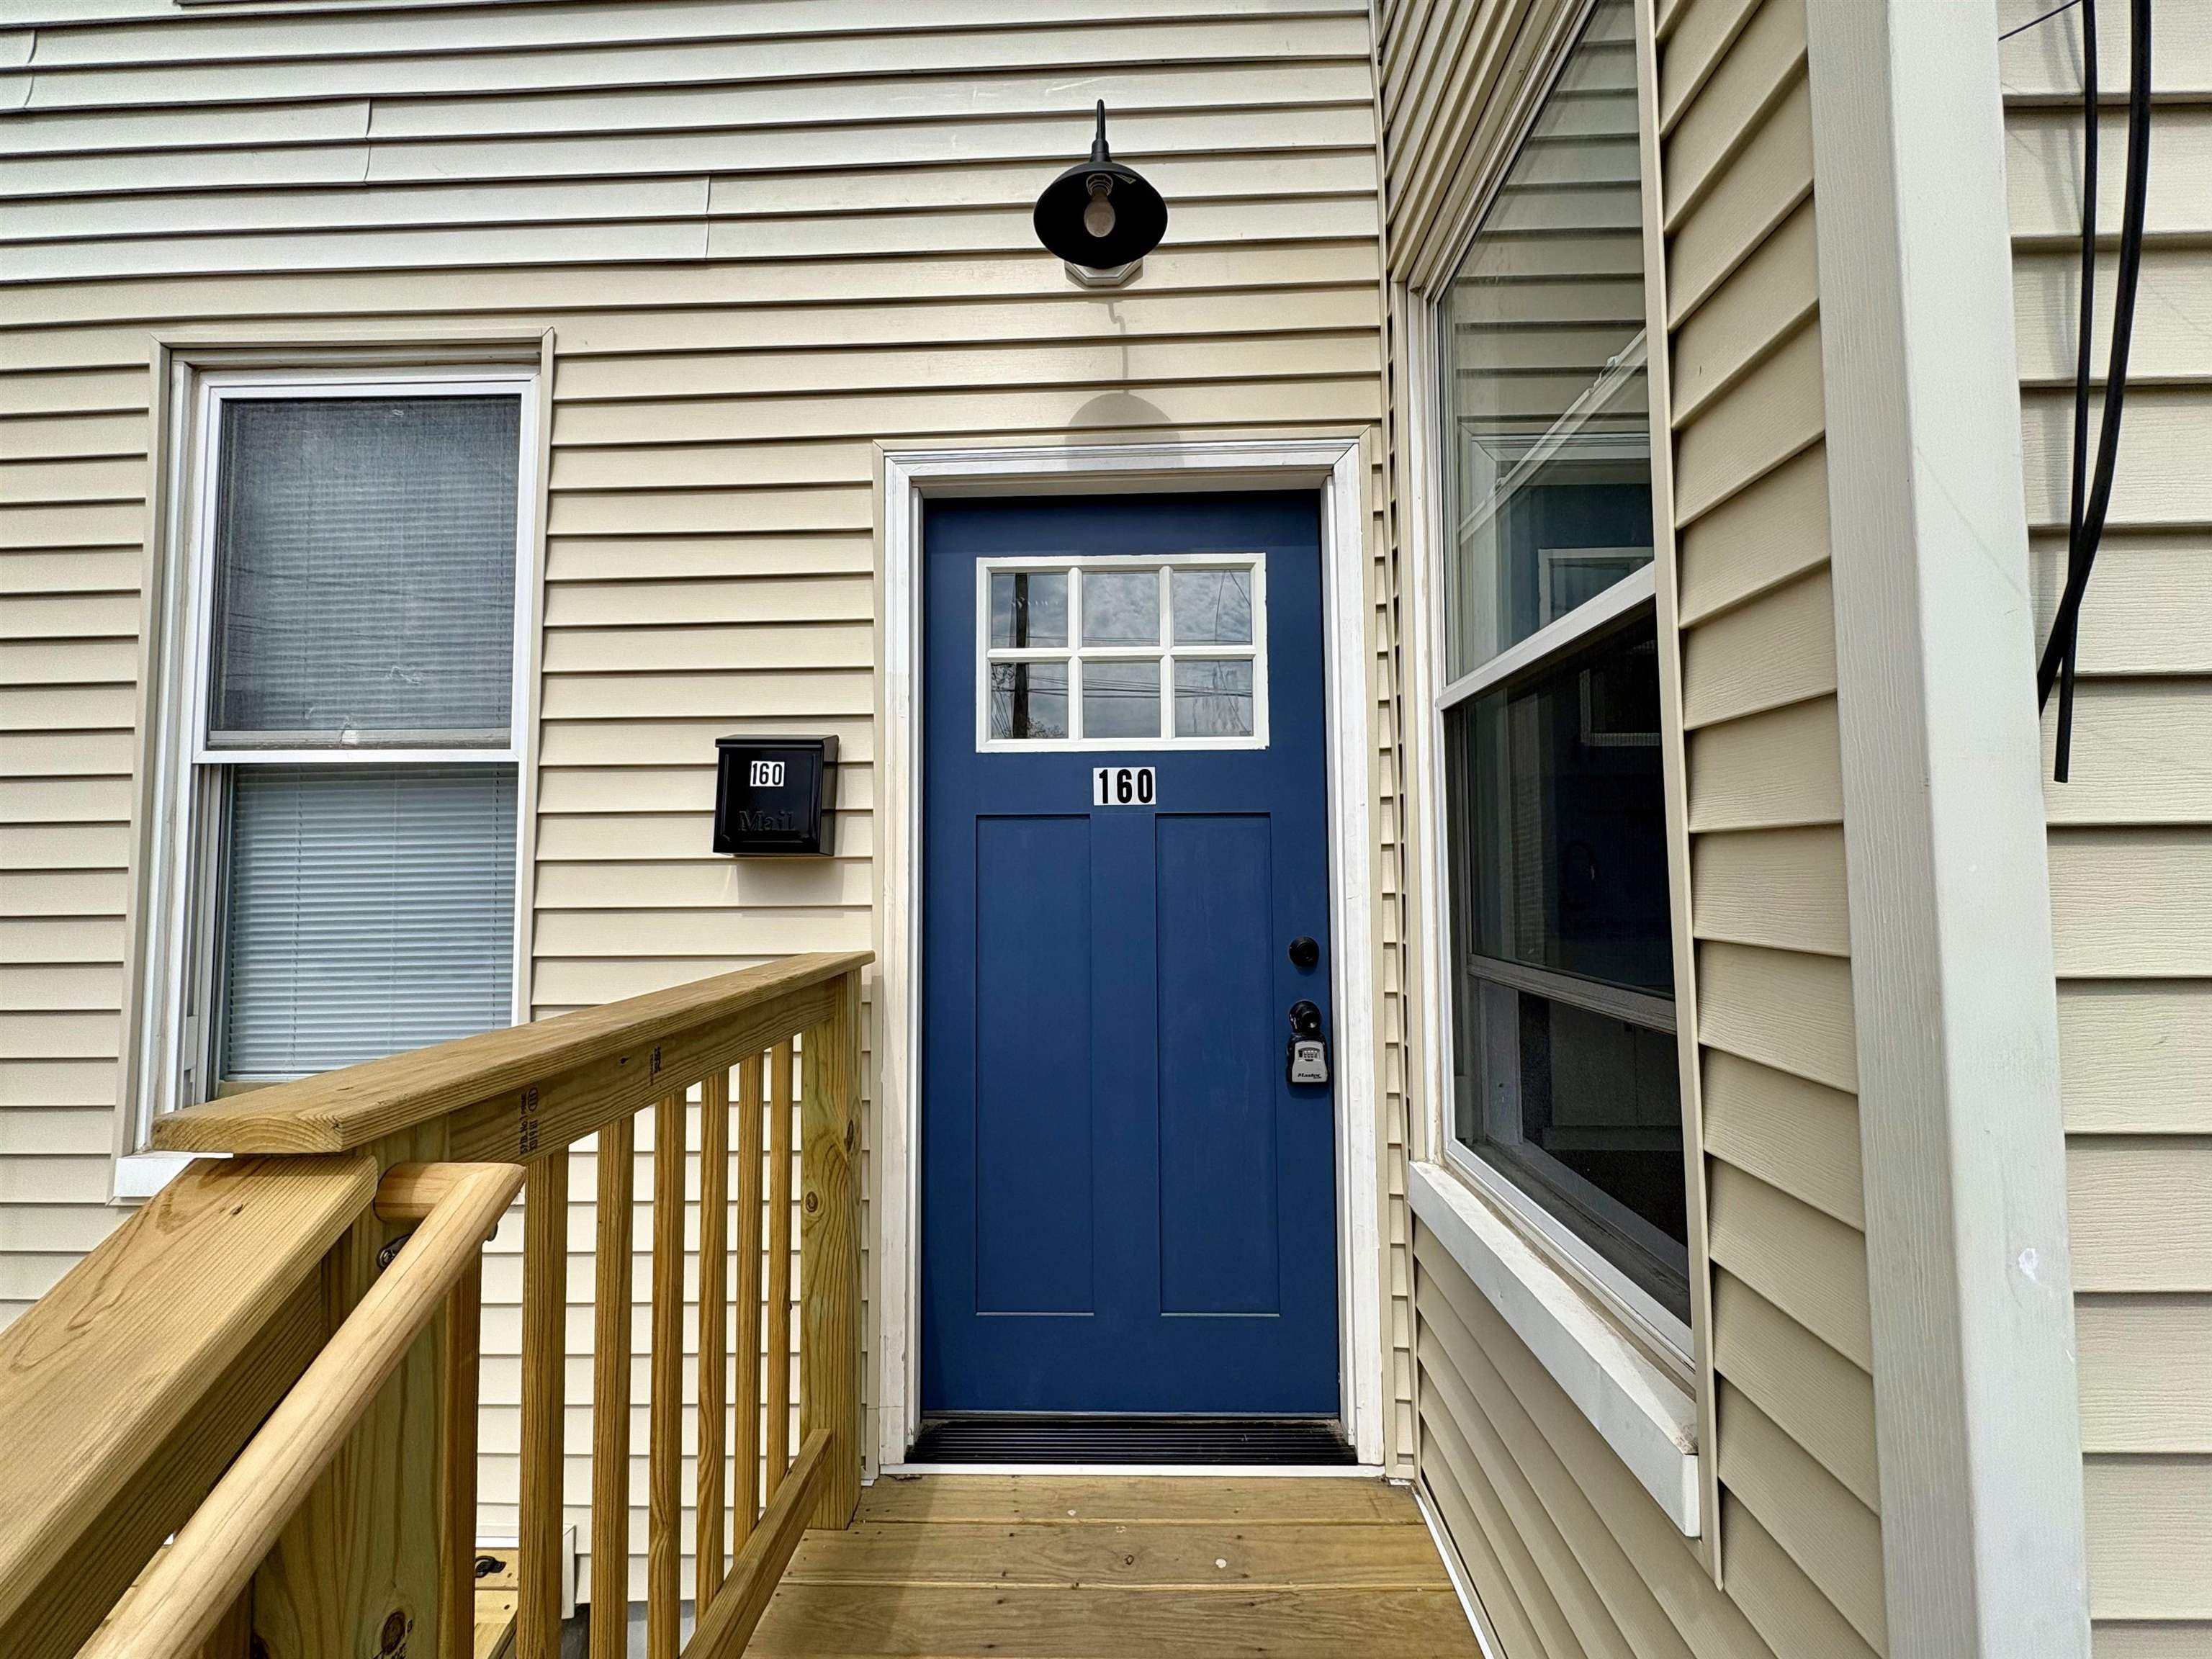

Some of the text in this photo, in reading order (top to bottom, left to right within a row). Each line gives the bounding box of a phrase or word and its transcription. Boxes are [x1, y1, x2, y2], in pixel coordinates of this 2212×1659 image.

[752, 763, 783, 786] 160
[1099, 769, 1153, 804] 160
[738, 810, 796, 831] Mail
